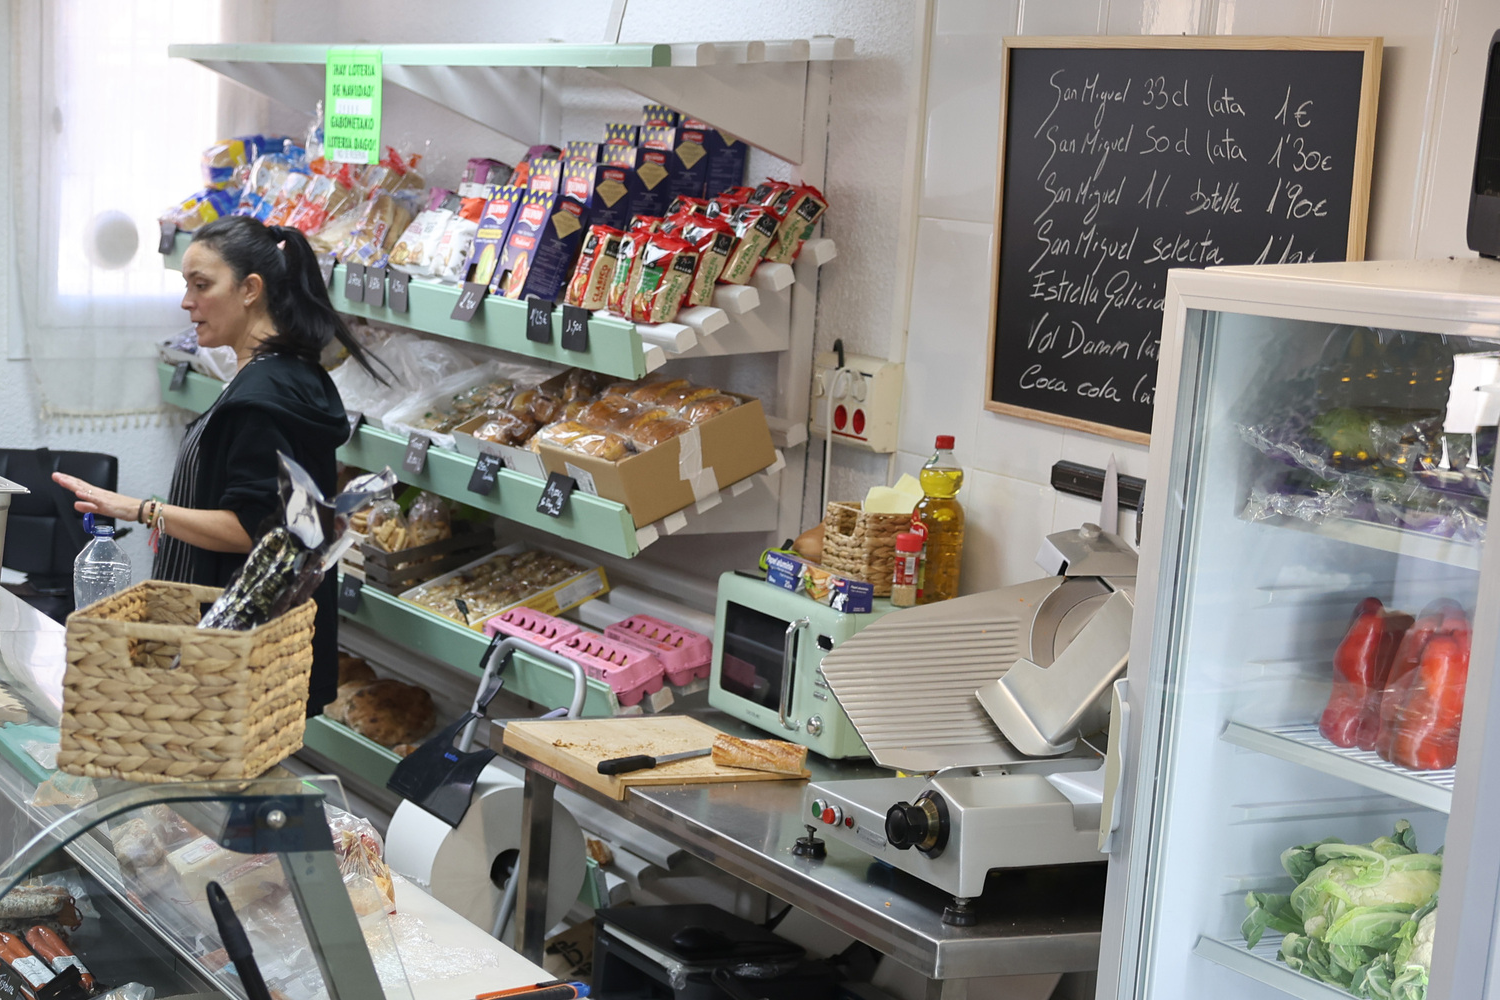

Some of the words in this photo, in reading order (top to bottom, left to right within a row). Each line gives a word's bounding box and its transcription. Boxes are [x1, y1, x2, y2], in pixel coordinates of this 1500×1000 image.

[1207, 74, 1245, 117] lata
[1207, 128, 1247, 164] lata
[1144, 229, 1224, 264] selecta
[1030, 270, 1100, 306] Estrella
[1019, 365, 1068, 392] Coca
[1077, 377, 1121, 402] cola
